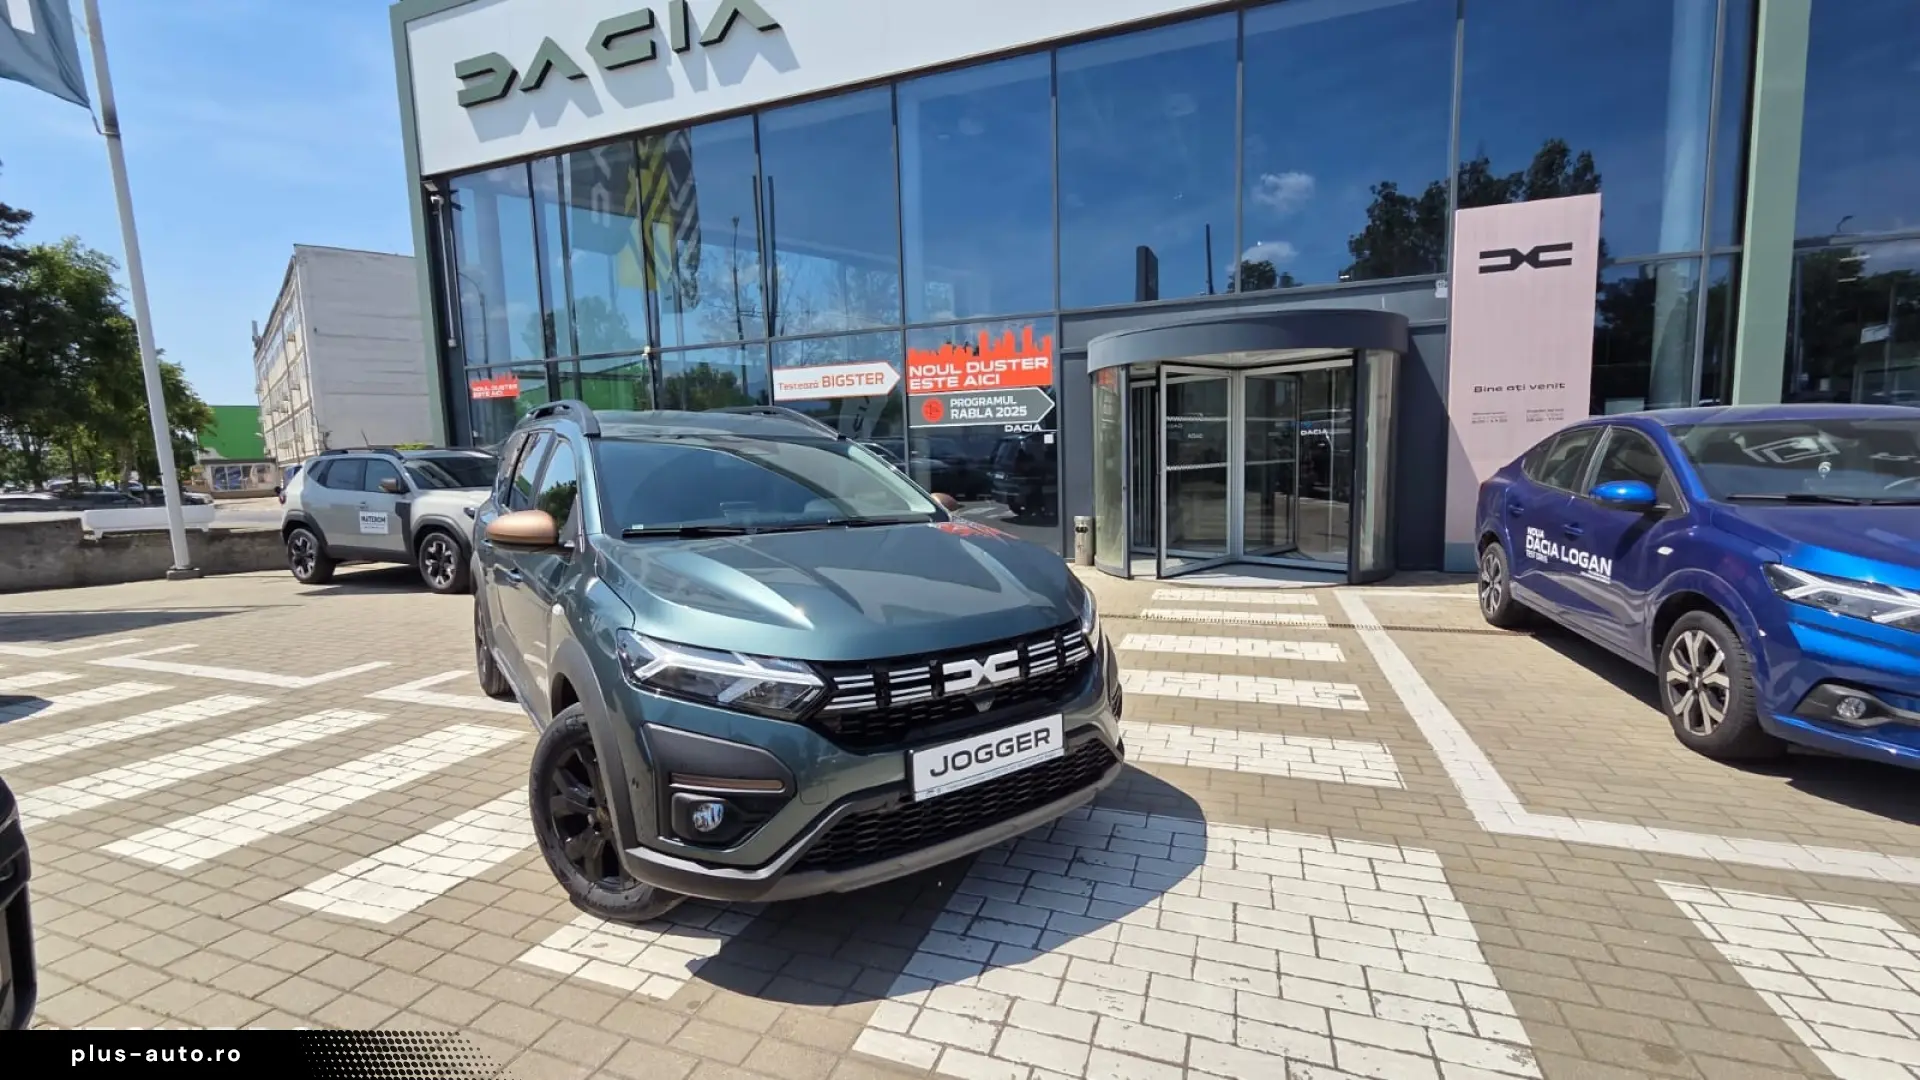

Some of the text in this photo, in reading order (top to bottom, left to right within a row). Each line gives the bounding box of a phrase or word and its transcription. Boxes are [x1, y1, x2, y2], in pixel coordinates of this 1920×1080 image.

[454, 0, 781, 108] DACIA
[908, 357, 1049, 377] NOUL DUSTER
[821, 372, 884, 388] BIGSTER
[909, 374, 1000, 390] ESTE AICI
[1474, 385, 1503, 393] Bine
[1529, 382, 1565, 390] venit
[950, 395, 1017, 408] PROGRAMUL
[951, 406, 1027, 420] RABLA 2025
[1004, 424, 1041, 433] DACIA
[1526, 534, 1560, 559] DACIA
[1561, 545, 1612, 577] LOGAN
[930, 727, 1050, 777] JOGGER
